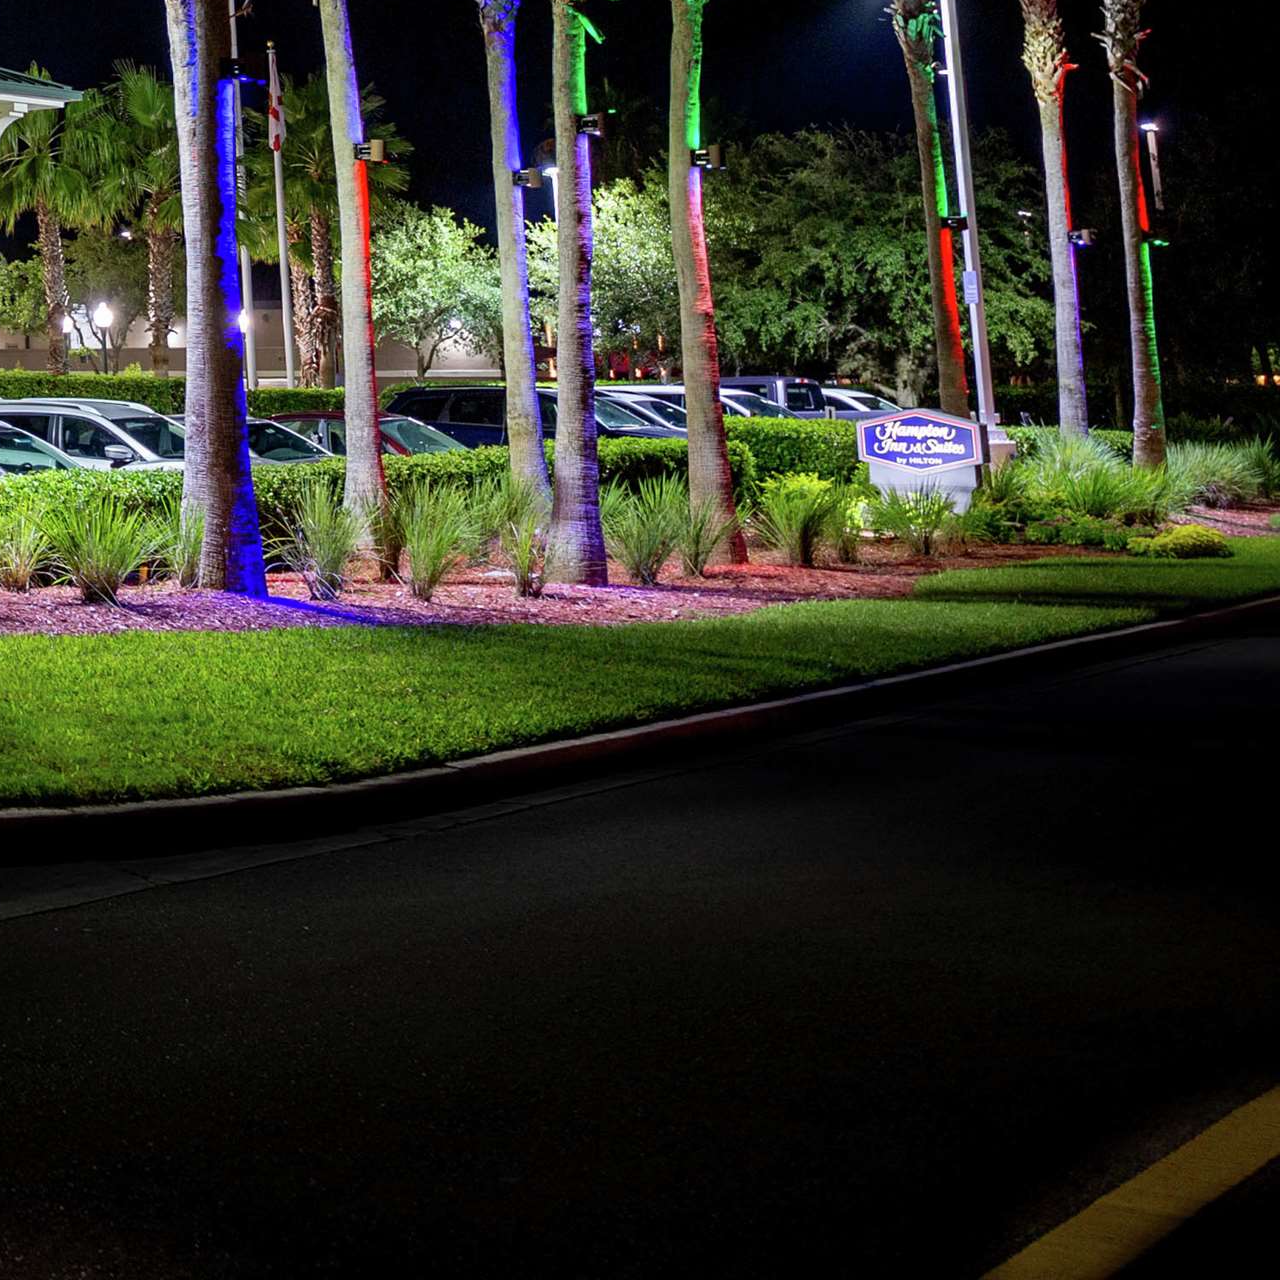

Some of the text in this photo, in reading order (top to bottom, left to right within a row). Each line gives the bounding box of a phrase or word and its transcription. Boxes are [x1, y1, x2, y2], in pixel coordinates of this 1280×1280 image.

[875, 421, 956, 440] Hampton
[873, 439, 965, 455] Inn & Suites
[896, 456, 907, 465] by
